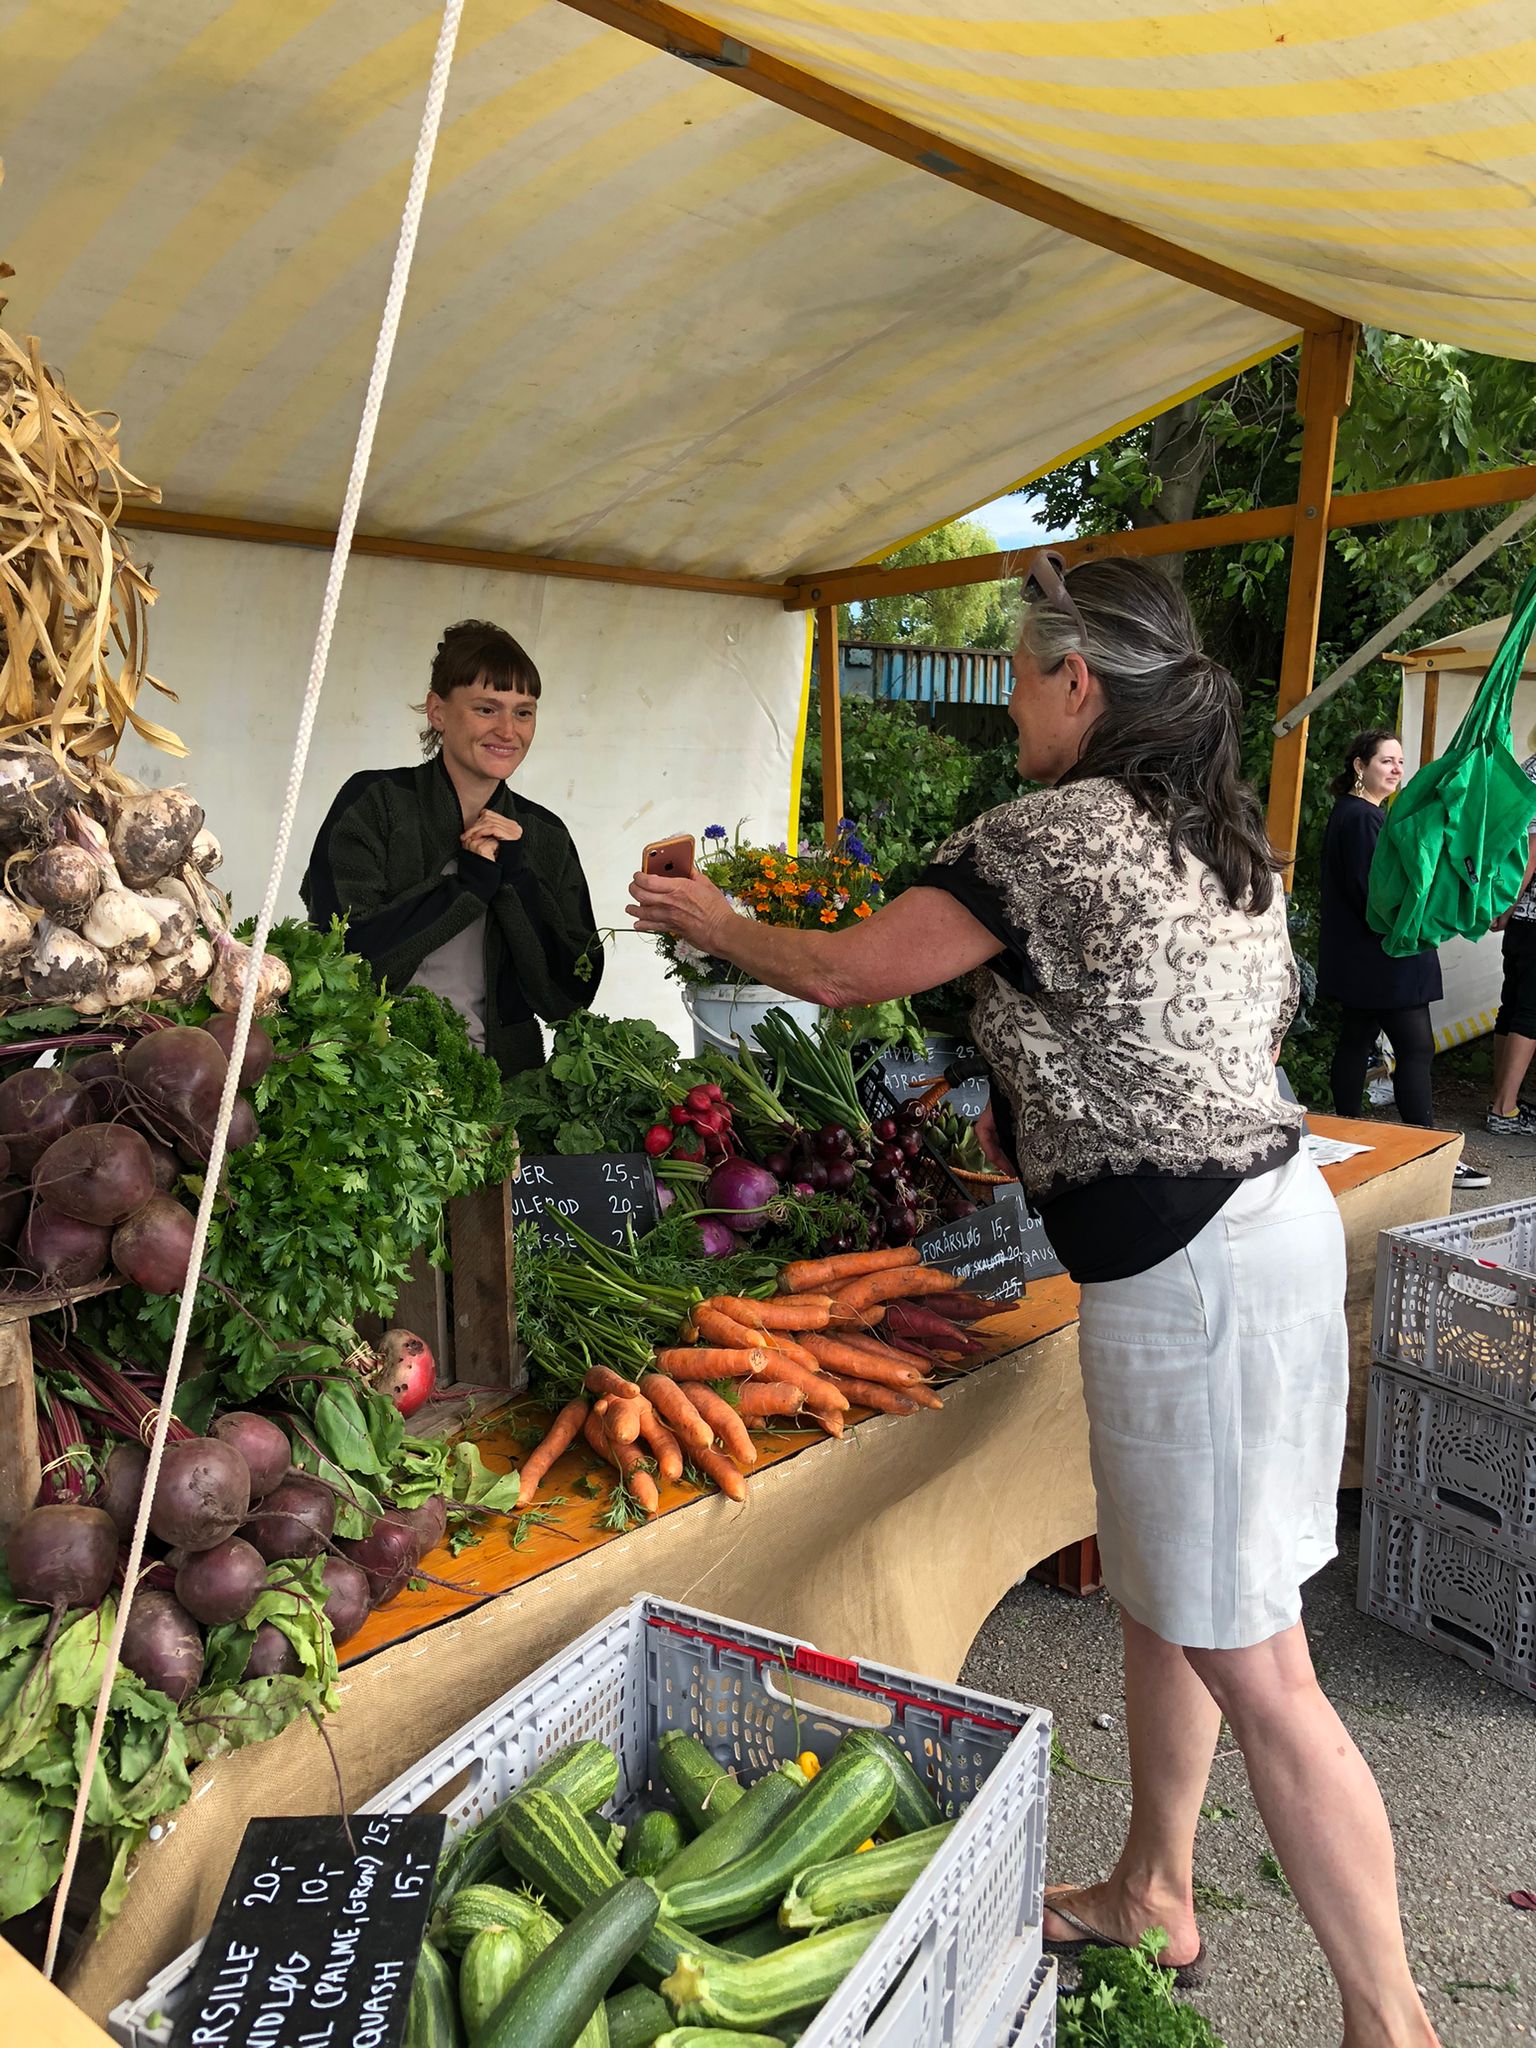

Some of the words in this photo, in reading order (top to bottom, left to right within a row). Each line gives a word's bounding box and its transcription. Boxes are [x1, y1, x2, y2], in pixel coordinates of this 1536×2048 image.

[962, 1103, 980, 1117] 20
[601, 1163, 640, 1190] 25,-
[608, 1195, 643, 1219] 20,-
[921, 1226, 981, 1264] FORÅRSLØG
[991, 1217, 1011, 1242] 15,-
[362, 1810, 403, 1845] 25,-
[297, 1862, 345, 1904] 10,-
[192, 1941, 260, 2048] RSILLE
[243, 1855, 296, 1907] 20,-
[353, 1961, 404, 2048] QUASH
[391, 1853, 431, 1898] 15,-
